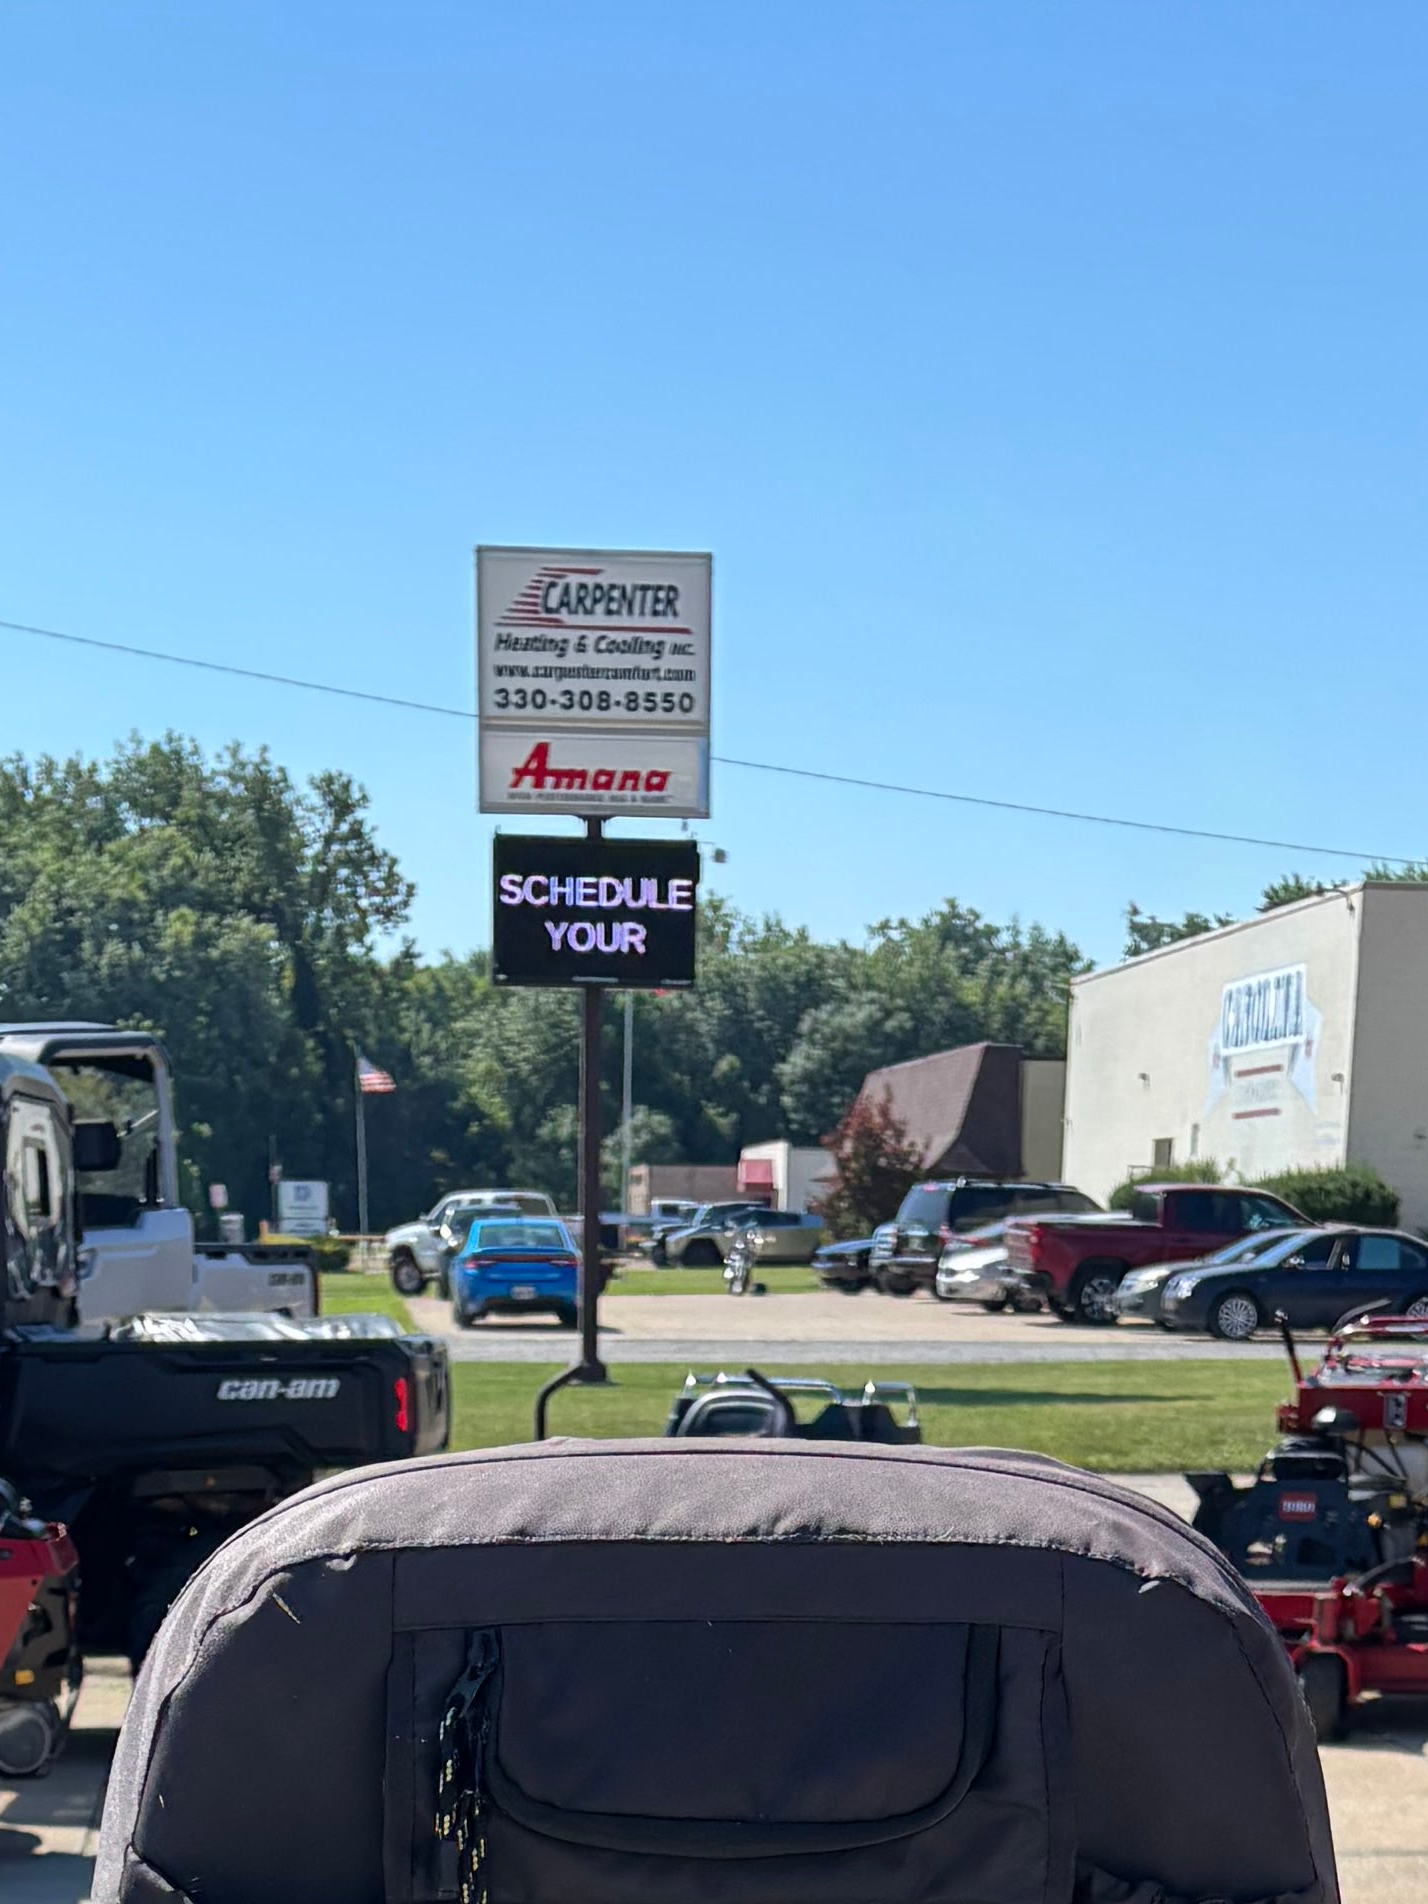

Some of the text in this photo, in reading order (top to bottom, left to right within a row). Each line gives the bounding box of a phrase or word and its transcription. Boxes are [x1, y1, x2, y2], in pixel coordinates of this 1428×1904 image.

[542, 581, 680, 617] CARPENTER
[494, 633, 570, 658] Heating
[575, 635, 588, 654] &
[594, 635, 665, 660] Cooling
[509, 742, 672, 792] Amana
[500, 874, 693, 910] SCHEDULE
[544, 920, 647, 954] YOUR
[217, 1378, 340, 1400] can-am
